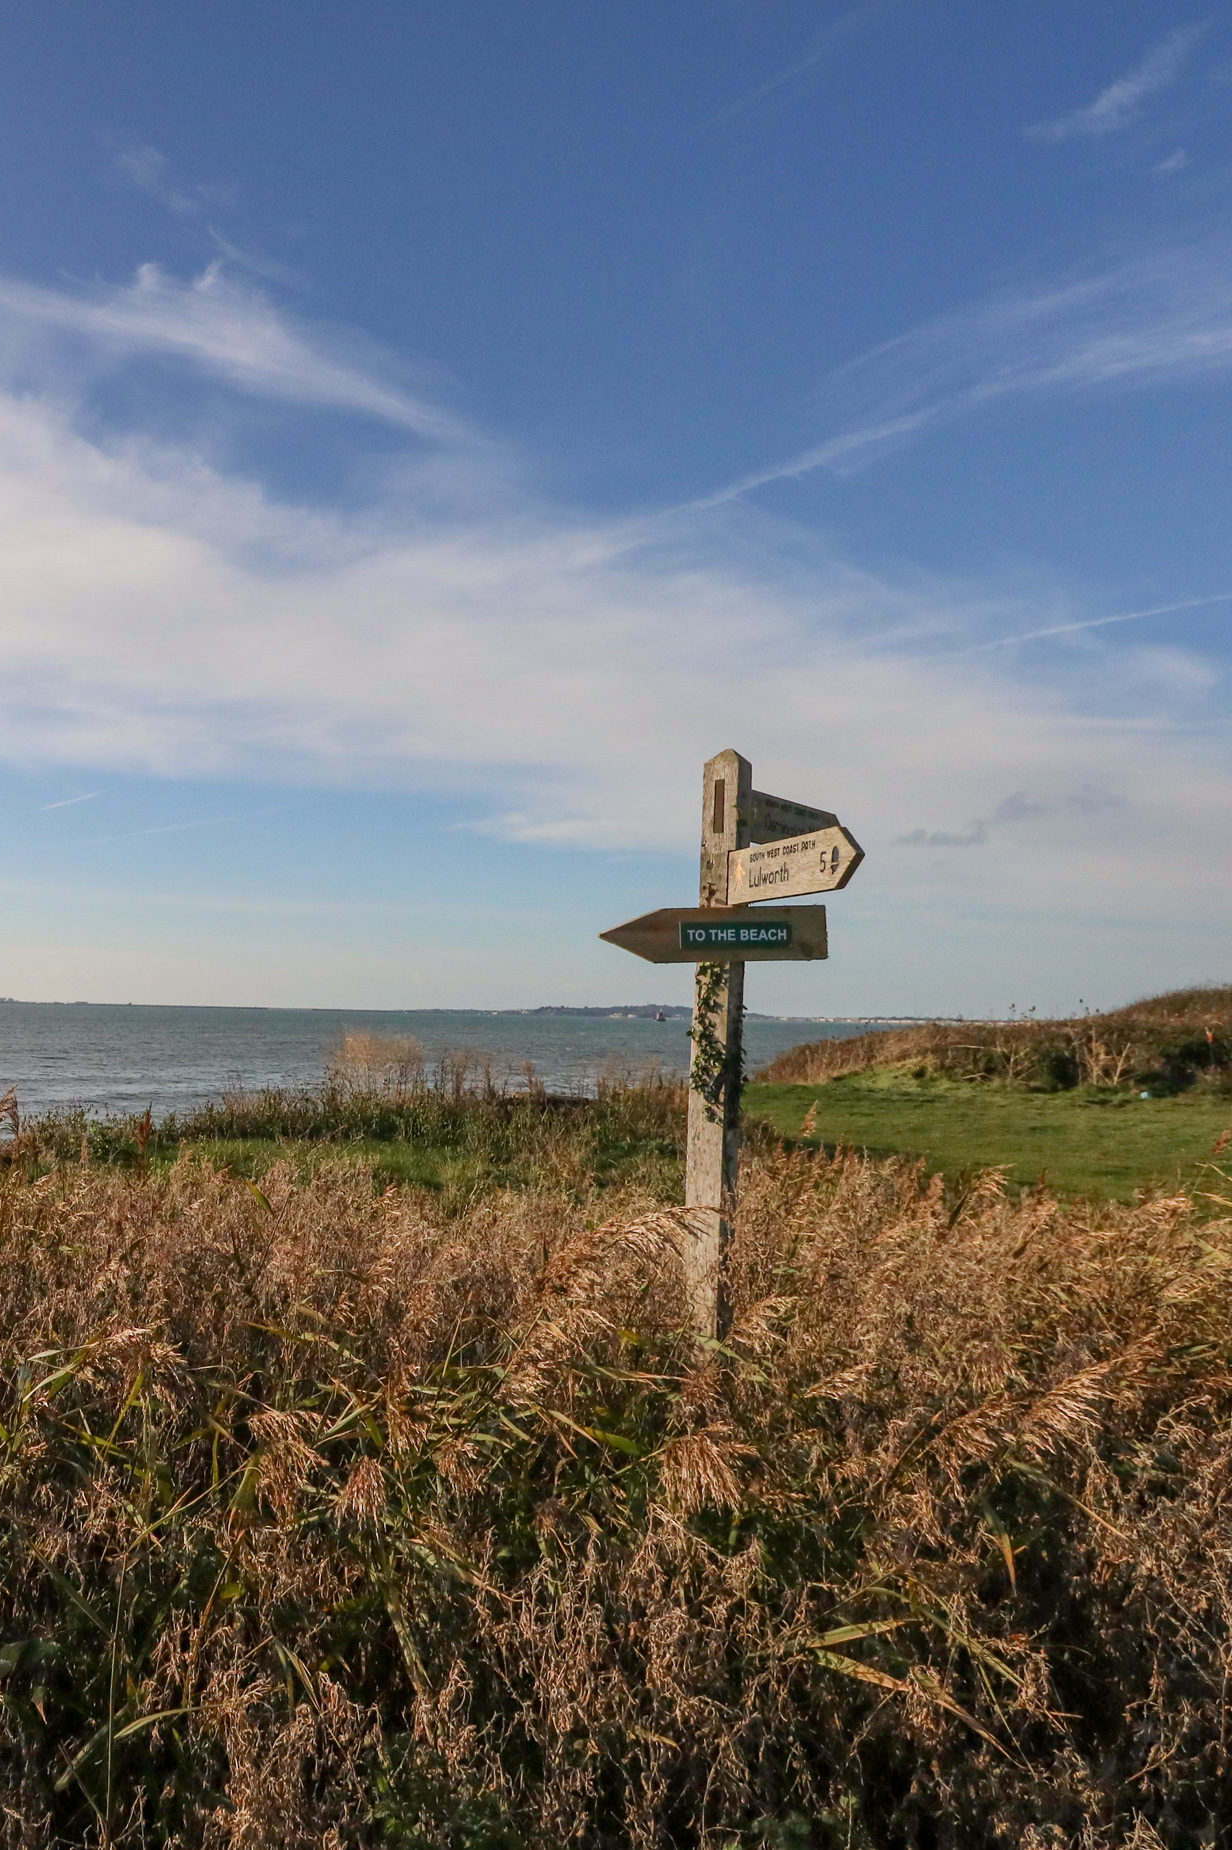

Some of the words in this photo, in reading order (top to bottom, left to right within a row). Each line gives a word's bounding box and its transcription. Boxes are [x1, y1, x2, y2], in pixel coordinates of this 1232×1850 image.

[750, 851, 765, 863] SOUTH
[767, 847, 780, 859] WEST
[782, 844, 799, 855] COAST
[801, 840, 816, 851] PATH
[748, 862, 789, 888] Lulworth
[819, 851, 826, 873] 5
[687, 929, 706, 941] TO
[709, 929, 736, 941] THE
[740, 929, 787, 941] BEACH
